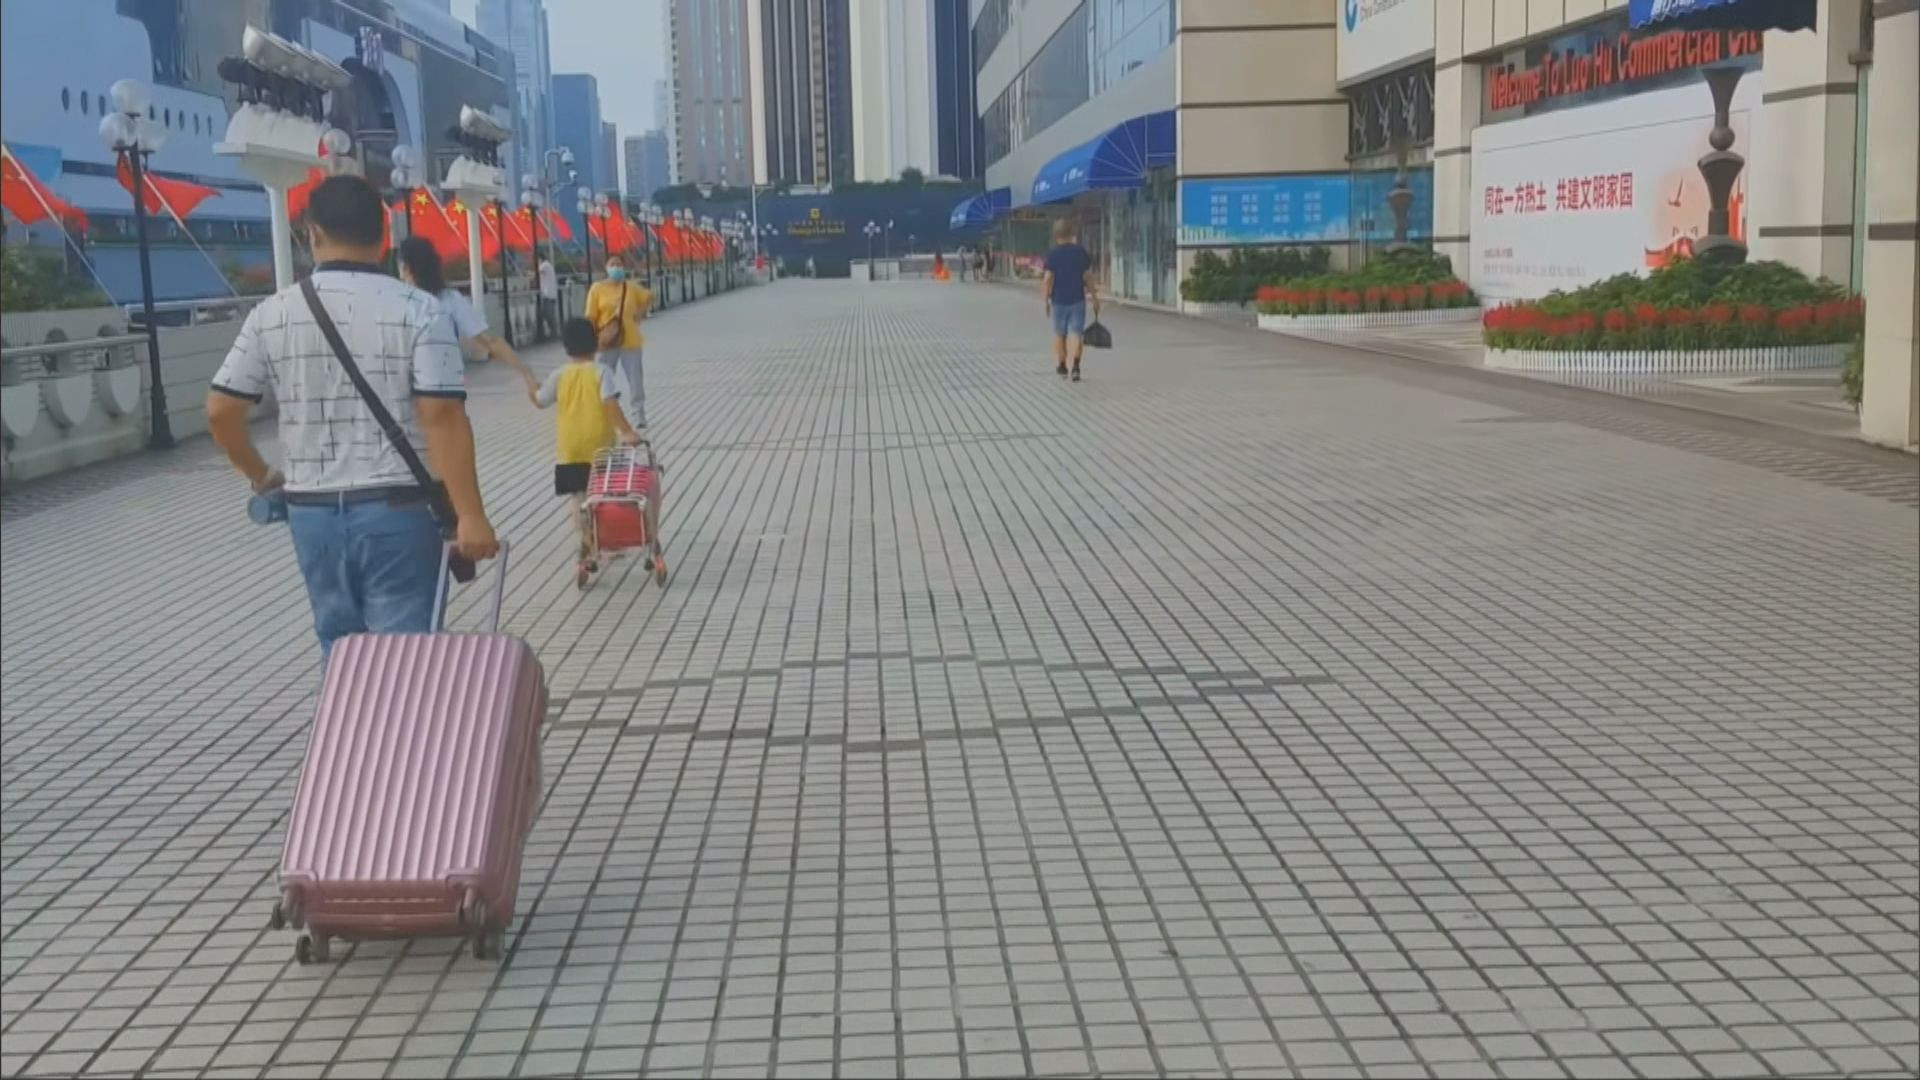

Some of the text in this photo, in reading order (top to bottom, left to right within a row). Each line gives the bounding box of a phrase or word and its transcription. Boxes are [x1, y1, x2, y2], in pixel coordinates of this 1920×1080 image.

[1489, 65, 1543, 111] Welcome
[1543, 53, 1559, 96] To
[1563, 51, 1589, 94] Luo
[1593, 40, 1613, 86] Hu
[1617, 31, 1720, 80] Commercial
[1484, 172, 1633, 216] 同在一方热土 共建文明家园
